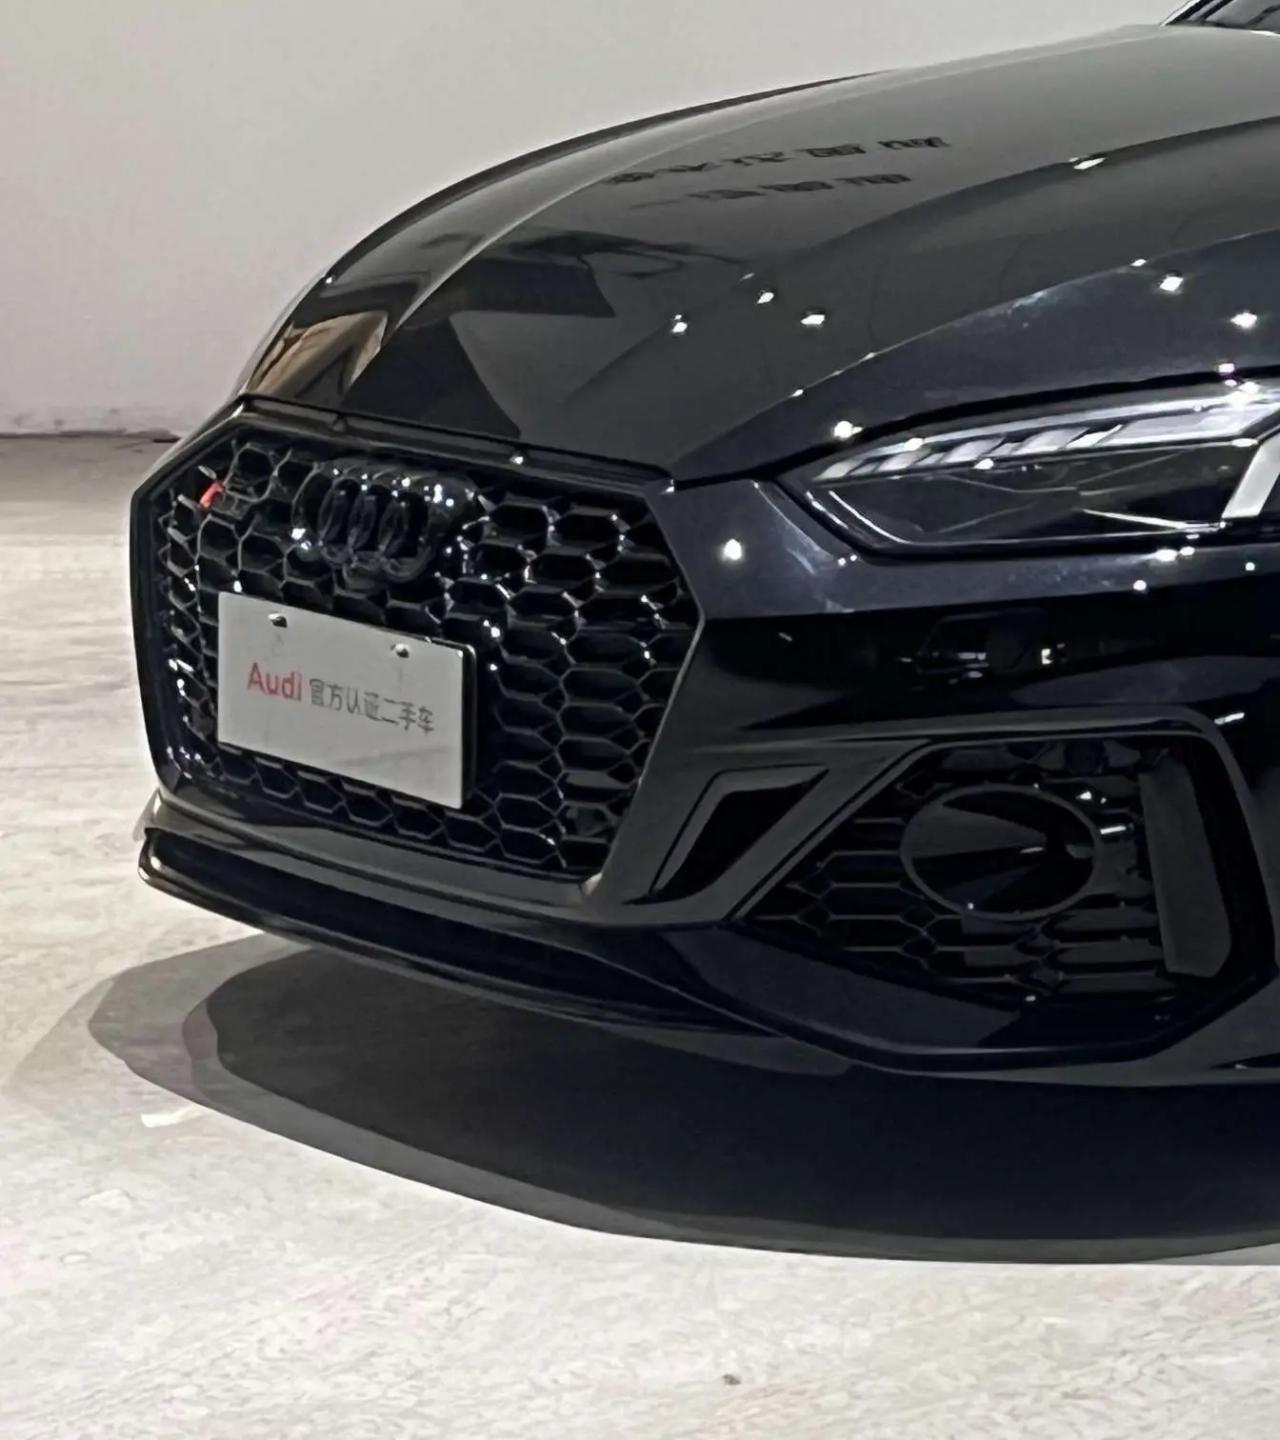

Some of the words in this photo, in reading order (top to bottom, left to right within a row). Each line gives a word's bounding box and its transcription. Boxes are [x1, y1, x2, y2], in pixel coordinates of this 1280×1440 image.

[247, 662, 302, 701] Audi
[309, 678, 435, 734] 官方认证二手车
